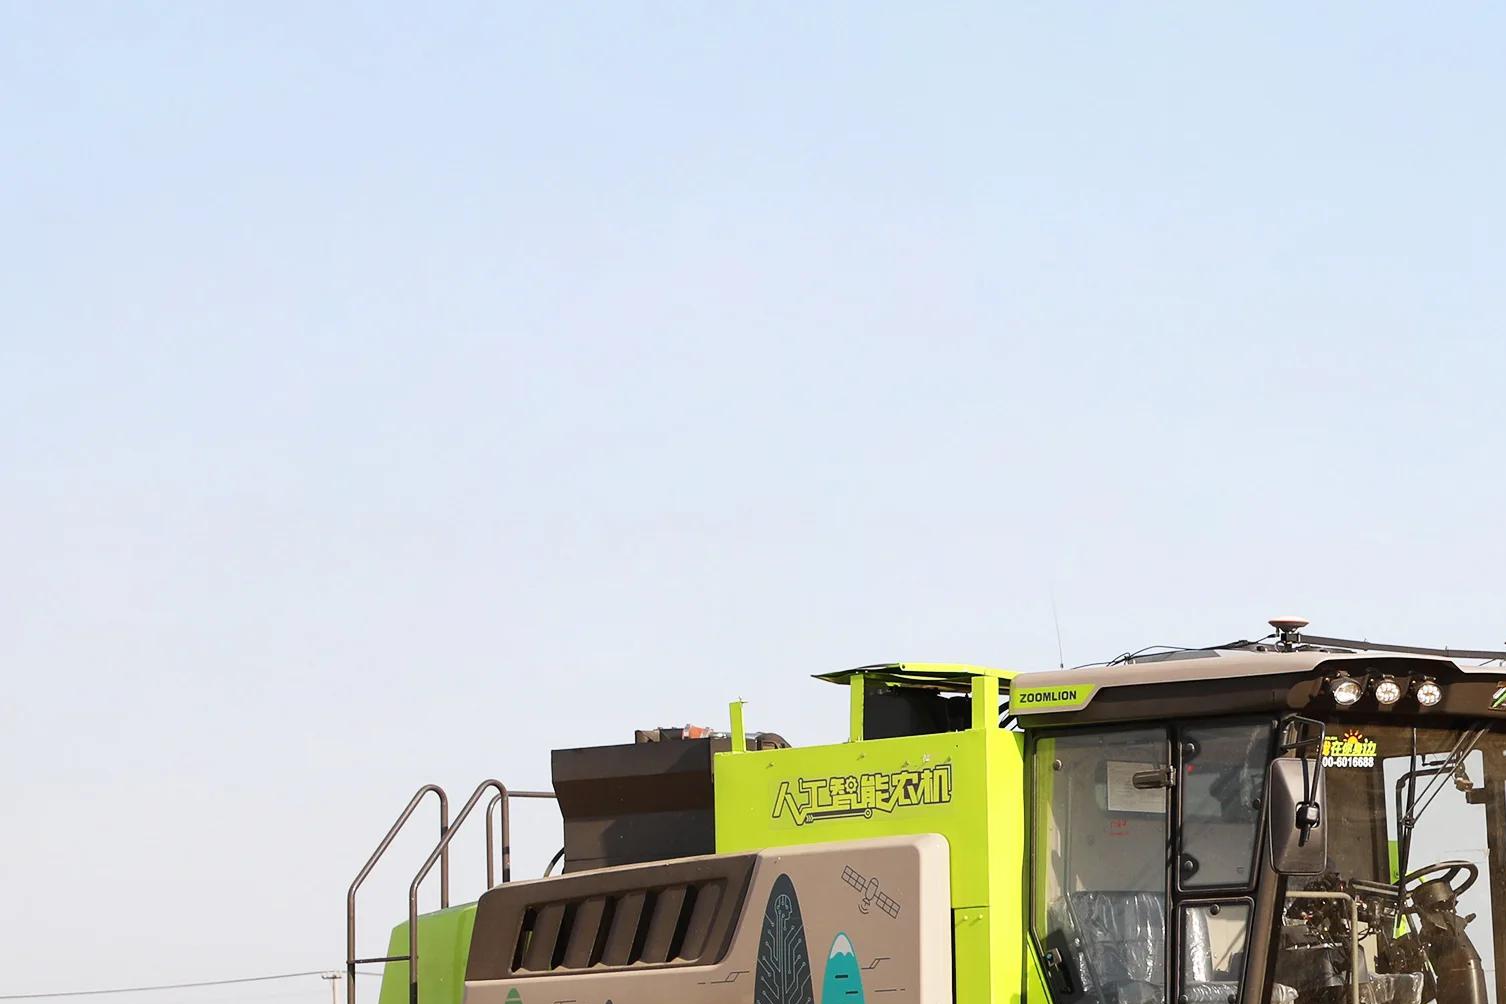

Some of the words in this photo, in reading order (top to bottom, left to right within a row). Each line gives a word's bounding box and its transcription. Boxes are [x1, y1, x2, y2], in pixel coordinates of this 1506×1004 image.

[1020, 690, 1077, 703] ZOOMLION
[1322, 756, 1375, 768] 00-6016688
[772, 764, 952, 827] 人工智能农机
